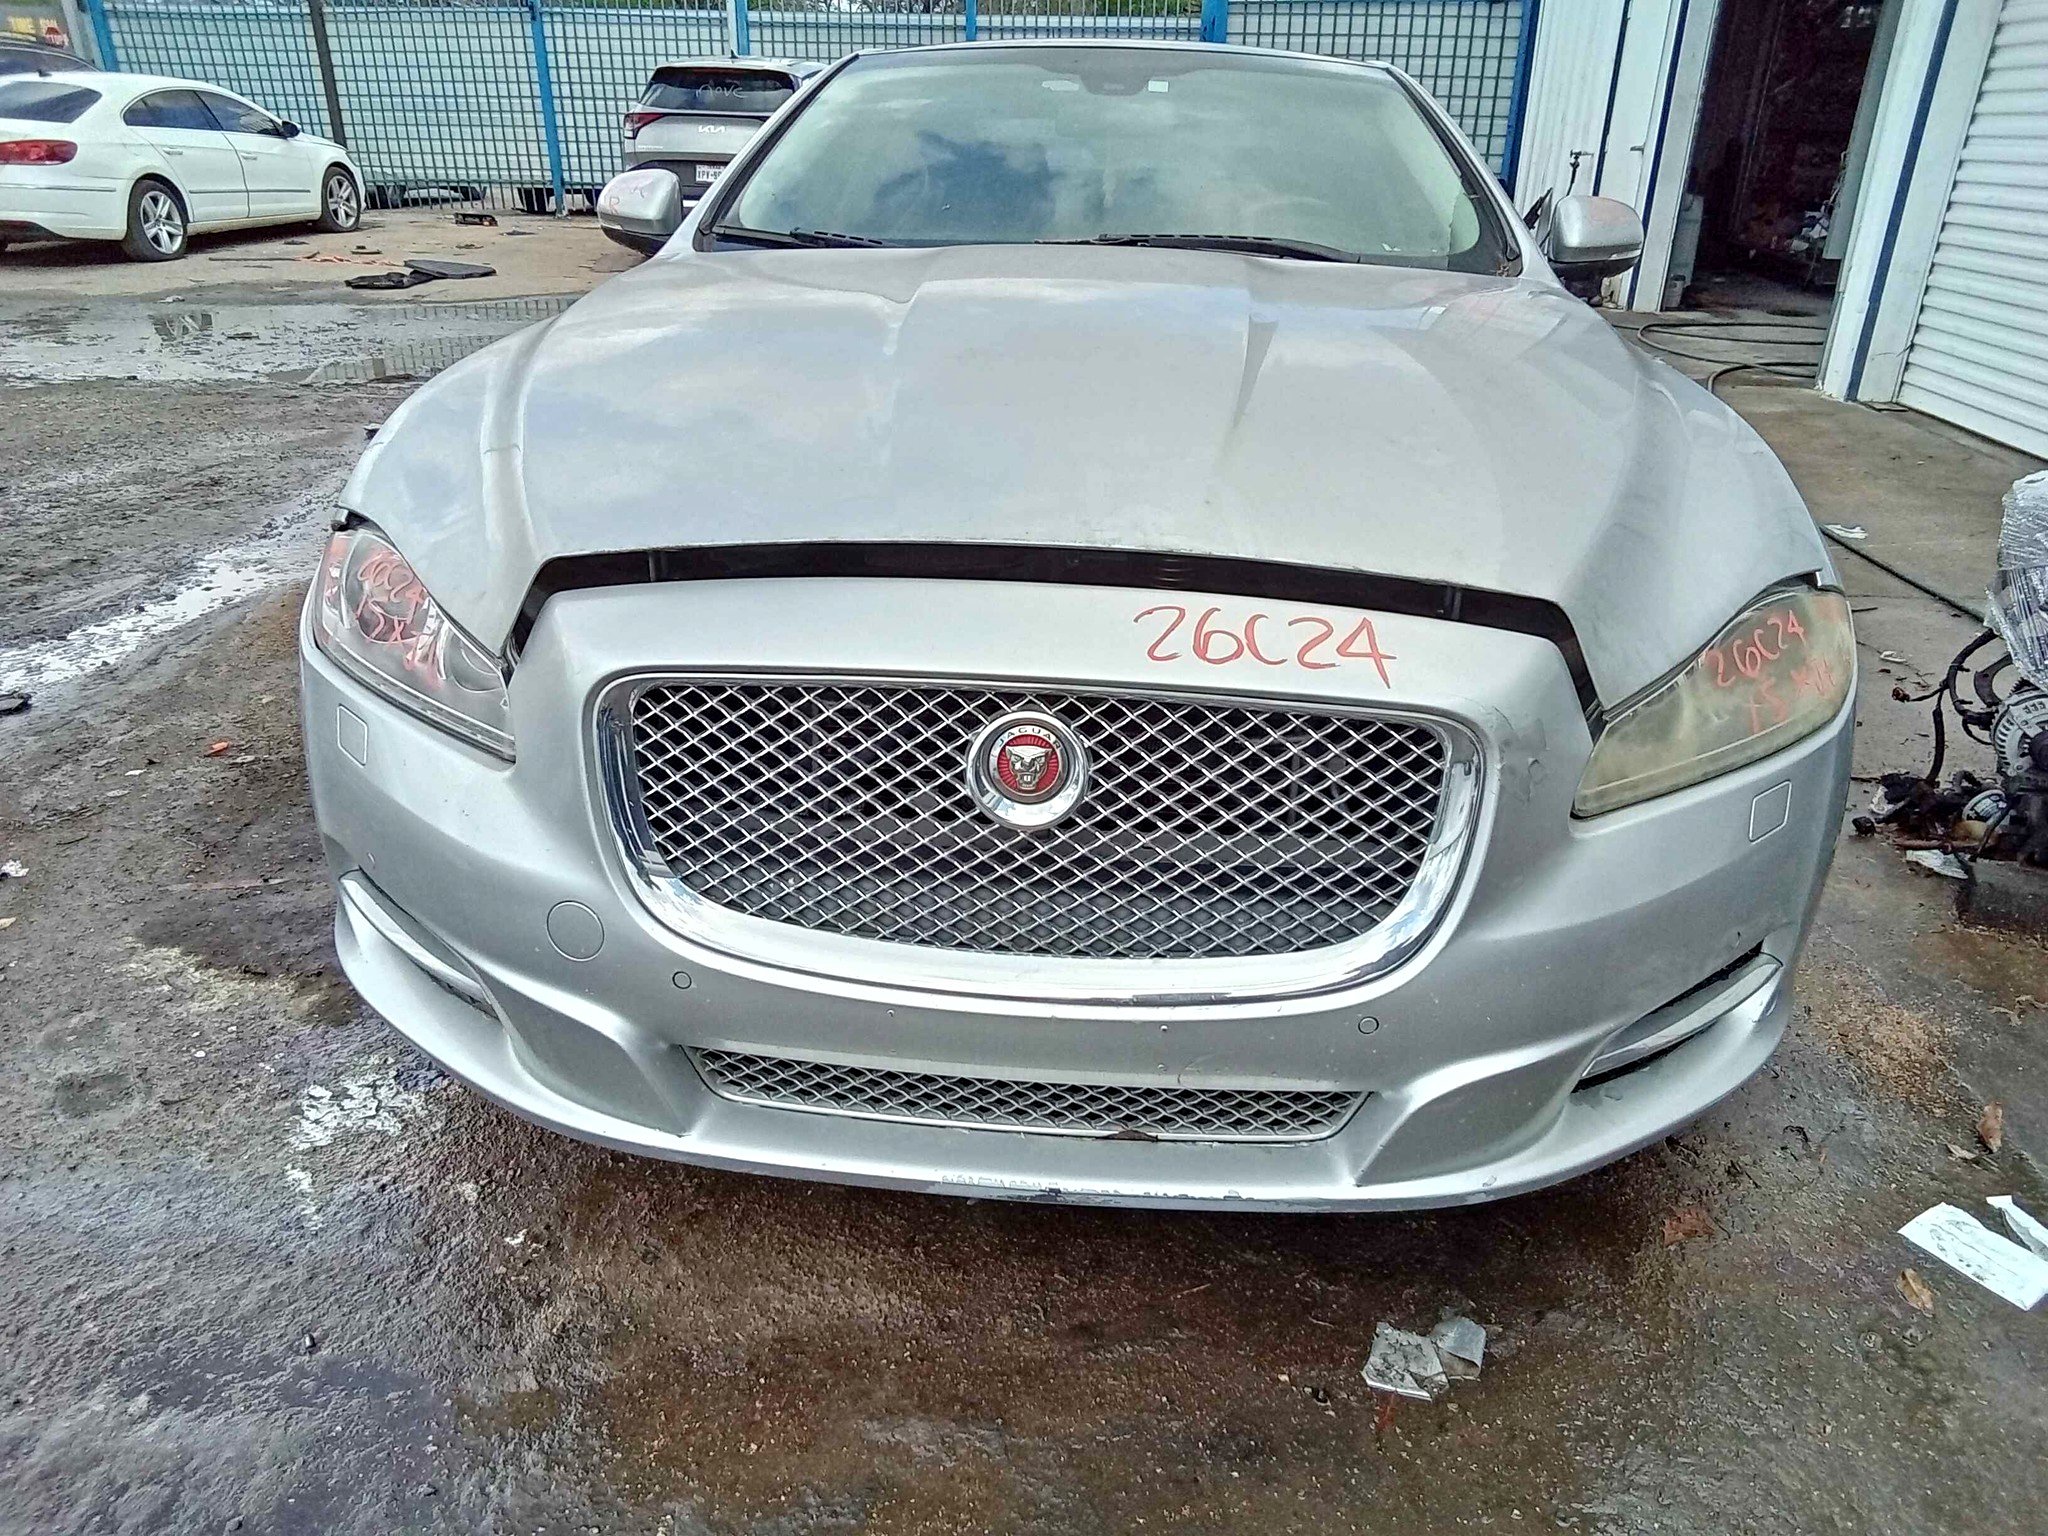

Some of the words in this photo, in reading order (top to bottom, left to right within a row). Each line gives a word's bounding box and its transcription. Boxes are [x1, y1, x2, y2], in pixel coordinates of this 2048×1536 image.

[1133, 605, 1397, 689] 26C24
[1705, 610, 1808, 688] 26C24
[997, 727, 1062, 750] JAGUAR
